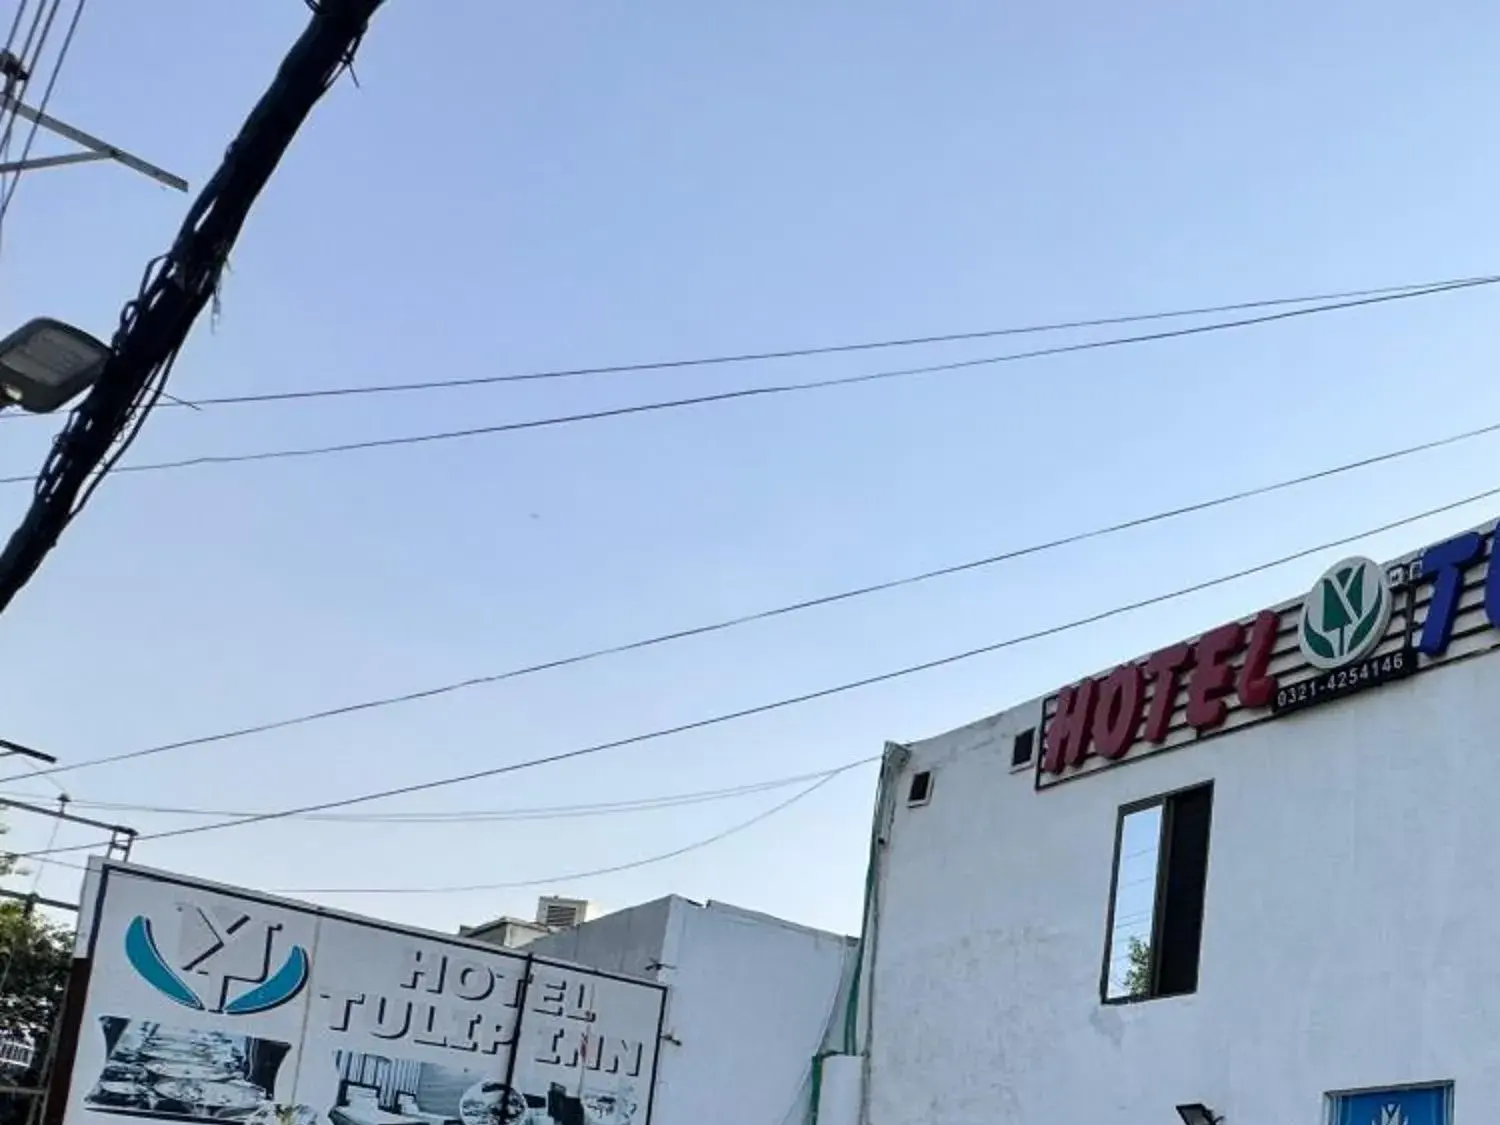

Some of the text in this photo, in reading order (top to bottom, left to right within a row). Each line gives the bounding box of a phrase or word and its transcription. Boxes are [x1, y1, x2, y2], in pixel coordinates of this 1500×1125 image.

[1043, 609, 1280, 774] HOTEL
[1277, 652, 1404, 707] 0321-4254146
[398, 949, 597, 1022] HOTEL
[319, 992, 643, 1077] TULIP INN
